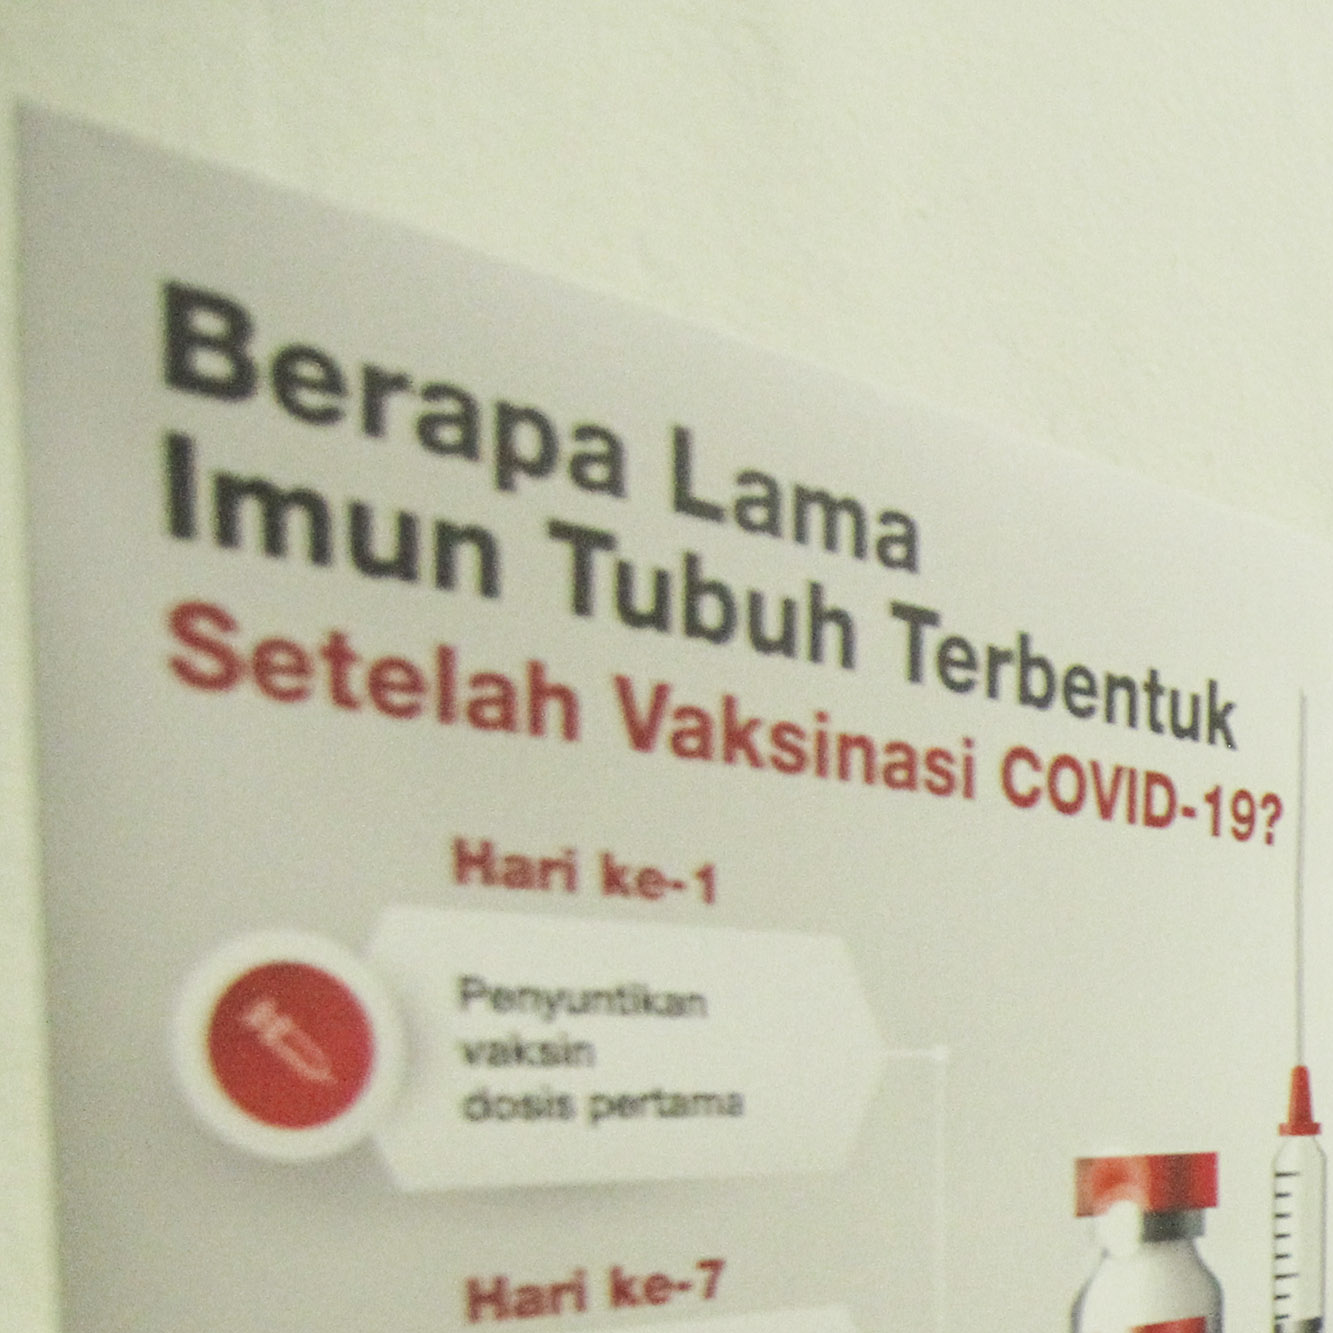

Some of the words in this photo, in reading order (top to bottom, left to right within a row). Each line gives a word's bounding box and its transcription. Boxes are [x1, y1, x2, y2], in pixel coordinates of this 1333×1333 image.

[162, 279, 627, 499] Berapa
[672, 424, 919, 573] Lama
[164, 431, 501, 599] Imun
[547, 518, 857, 669] Tubuh
[890, 600, 1237, 750] Terbentuk
[167, 600, 581, 742] Setelah
[612, 674, 976, 799] Vaksinasi
[1001, 744, 1283, 846] COVID-19?
[452, 836, 578, 893] Hari
[601, 851, 718, 905] ke-1
[459, 974, 710, 1024] Penyuntikan
[459, 1032, 597, 1068] vaksin
[460, 1087, 577, 1122] dosis
[587, 1088, 746, 1128] pertama
[464, 1268, 588, 1325] Hari
[609, 1258, 727, 1309] ke-7
